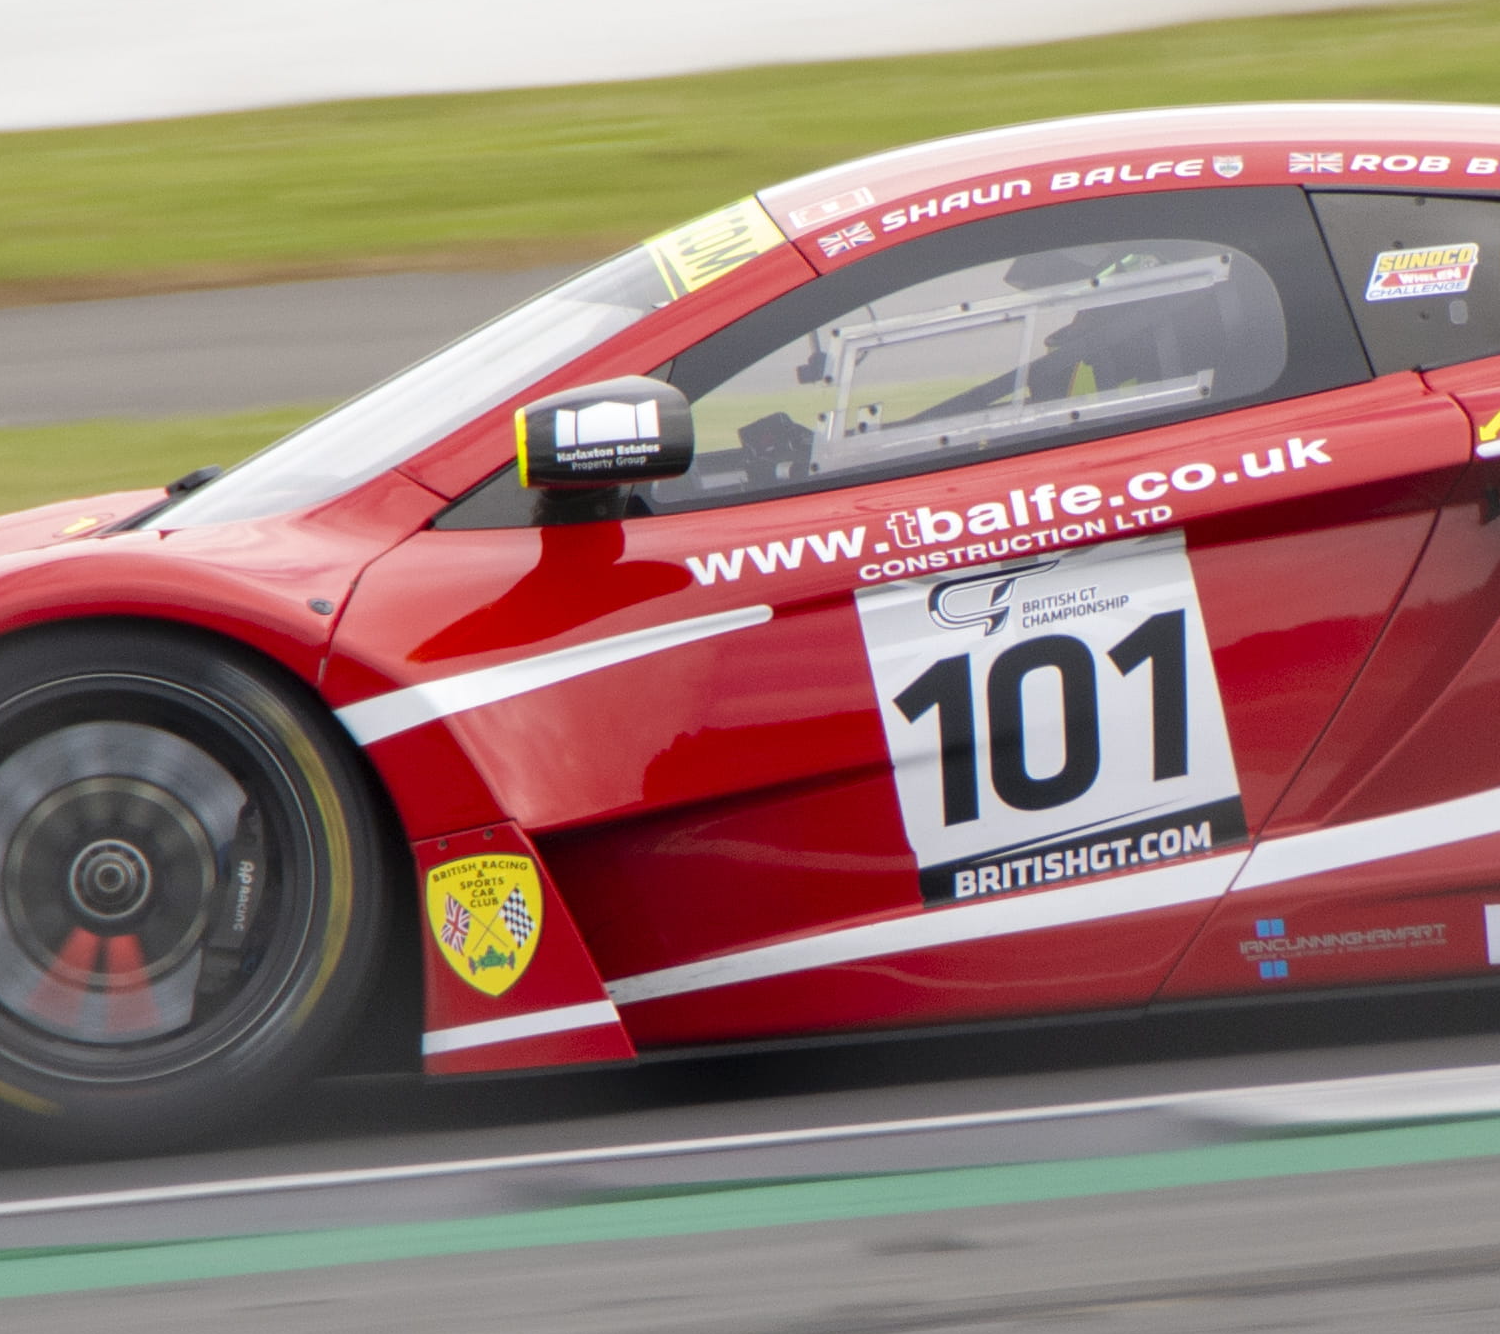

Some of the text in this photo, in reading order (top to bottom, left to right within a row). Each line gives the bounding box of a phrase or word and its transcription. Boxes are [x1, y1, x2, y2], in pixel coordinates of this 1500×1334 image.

[1350, 154, 1450, 172] ROB
[881, 159, 1204, 232] SHAUN BALFE
[1378, 248, 1473, 273] SUNOCO
[1369, 281, 1466, 298] CHALLENGE
[616, 444, 660, 455] Estates
[572, 455, 647, 471] Property Group
[687, 437, 1332, 586] www.tbalfe.co.uk
[859, 504, 1173, 581] CONSTRUCTION LTD
[1022, 587, 1098, 614] BRITISH GT
[1022, 594, 1130, 629] CHAMPIONSHIP
[893, 608, 1189, 827] 101
[432, 860, 528, 883] BRITISH RACING
[954, 821, 1211, 898] BRITISHGT.COM
[460, 877, 504, 890] SPORTS
[472, 888, 494, 898] CAR
[470, 897, 499, 908] CLUB
